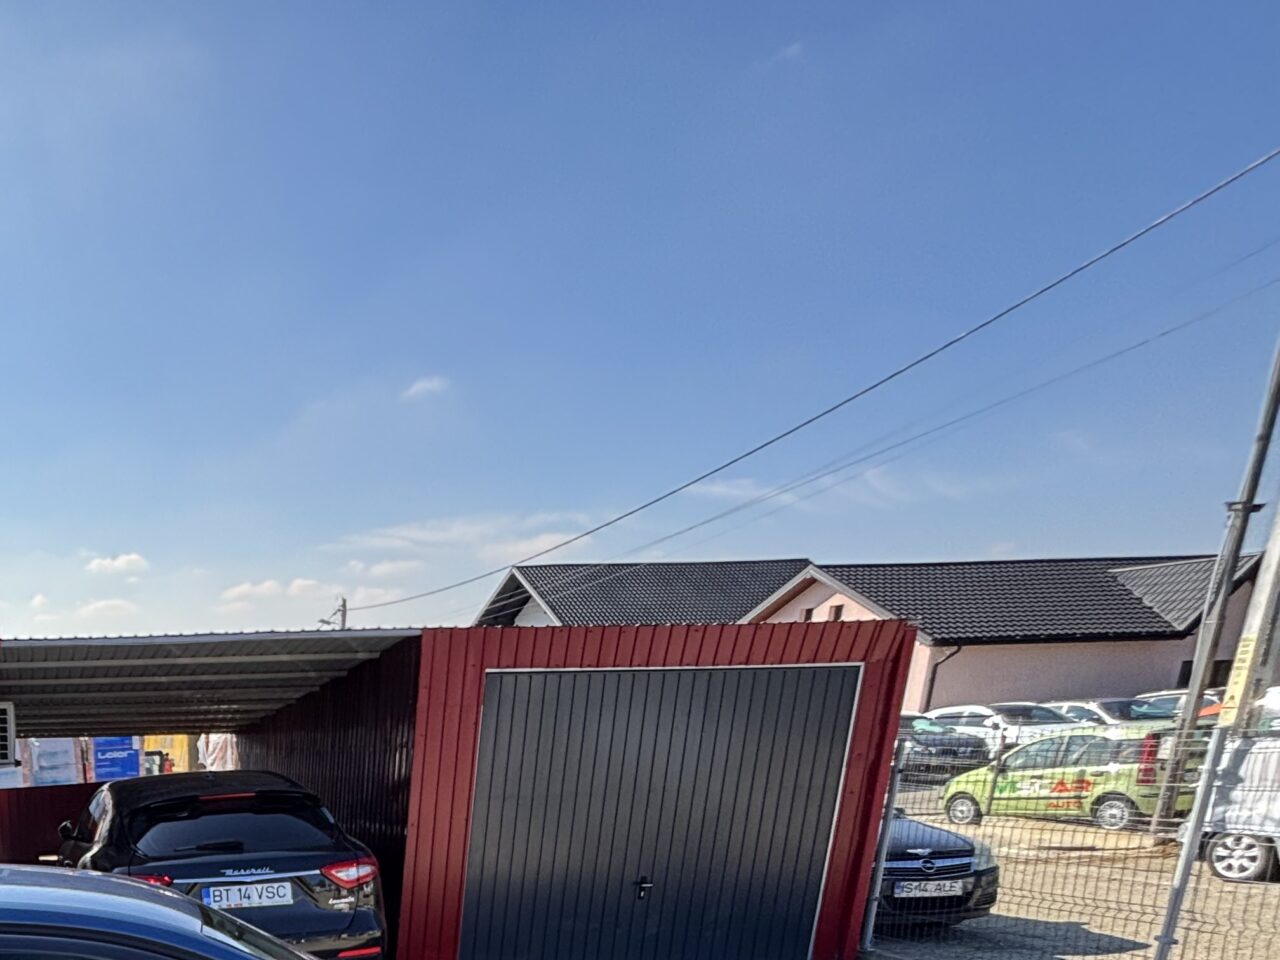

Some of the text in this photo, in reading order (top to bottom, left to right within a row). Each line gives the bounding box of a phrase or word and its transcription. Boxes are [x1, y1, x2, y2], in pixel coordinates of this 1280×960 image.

[212, 884, 287, 904] BT 14 VSC
